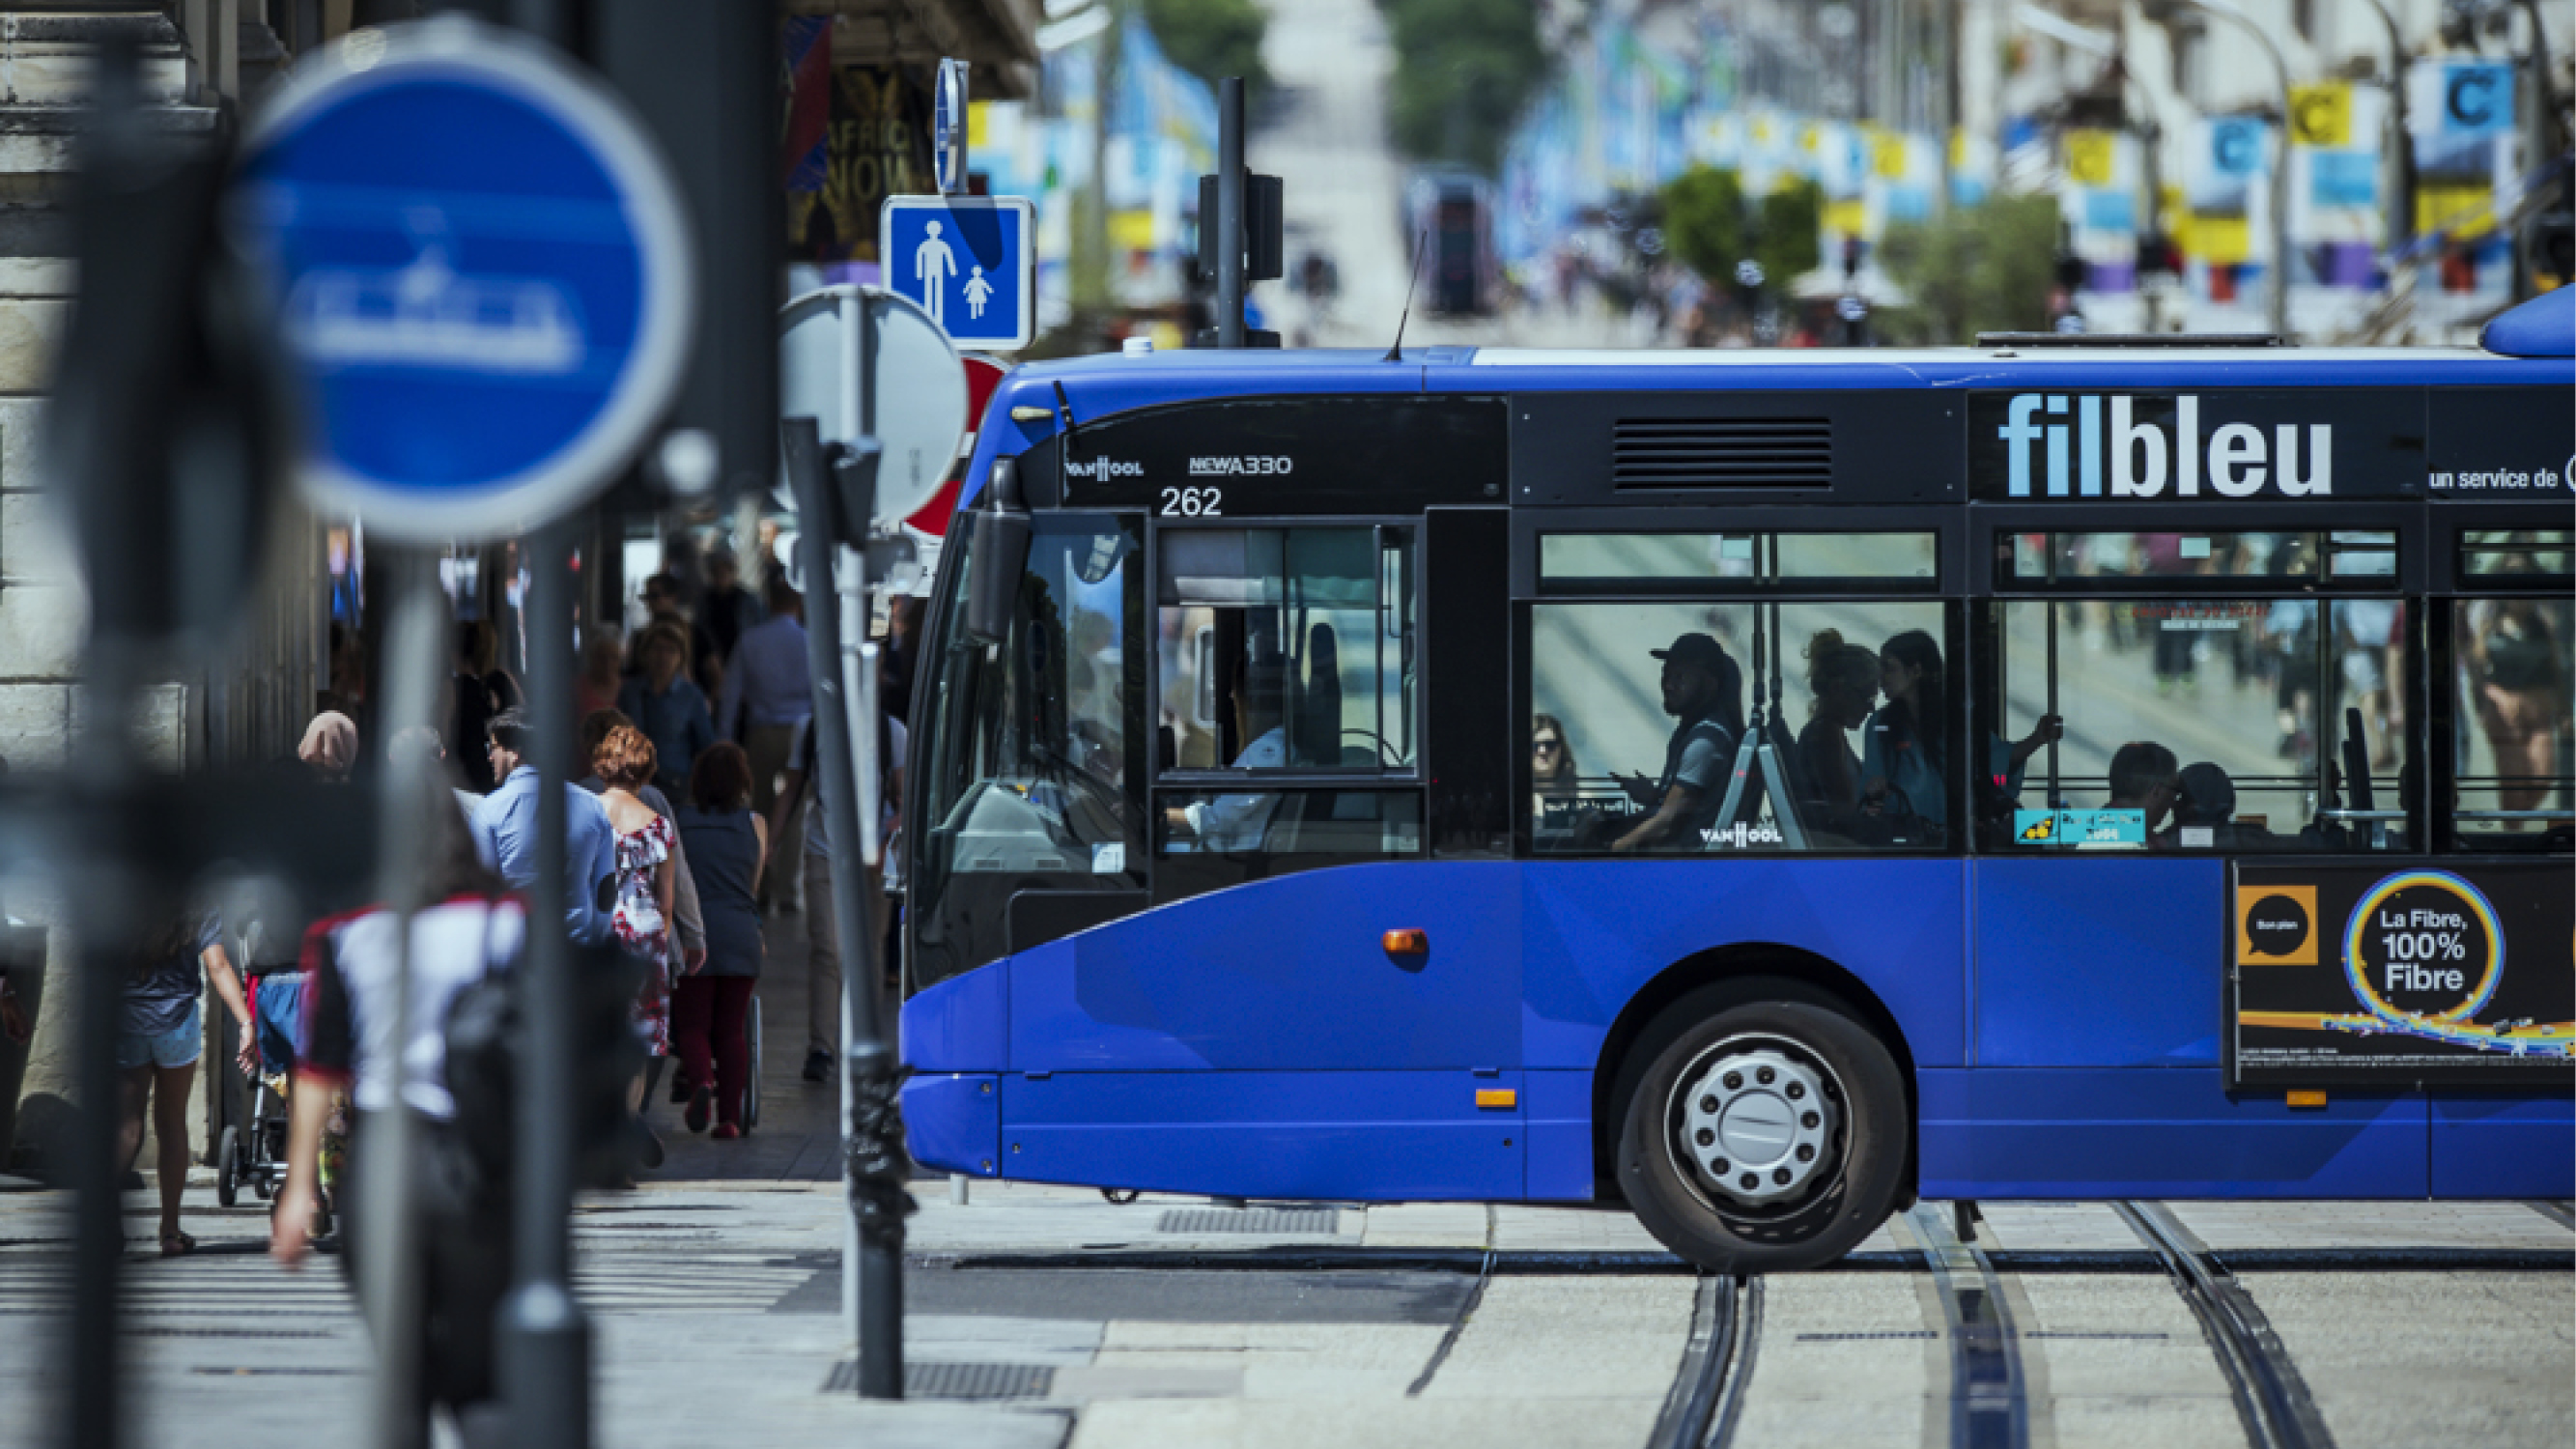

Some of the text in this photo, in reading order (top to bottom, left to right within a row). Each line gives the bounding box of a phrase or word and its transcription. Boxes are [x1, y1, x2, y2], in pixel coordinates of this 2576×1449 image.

[1998, 393, 2333, 497] filbleu
[2428, 468, 2559, 489] un service de
[1161, 486, 1222, 517] 262
[2380, 909, 2468, 931] La Fibre,
[2382, 932, 2466, 960] 100%
[2385, 962, 2465, 991] Fibre
